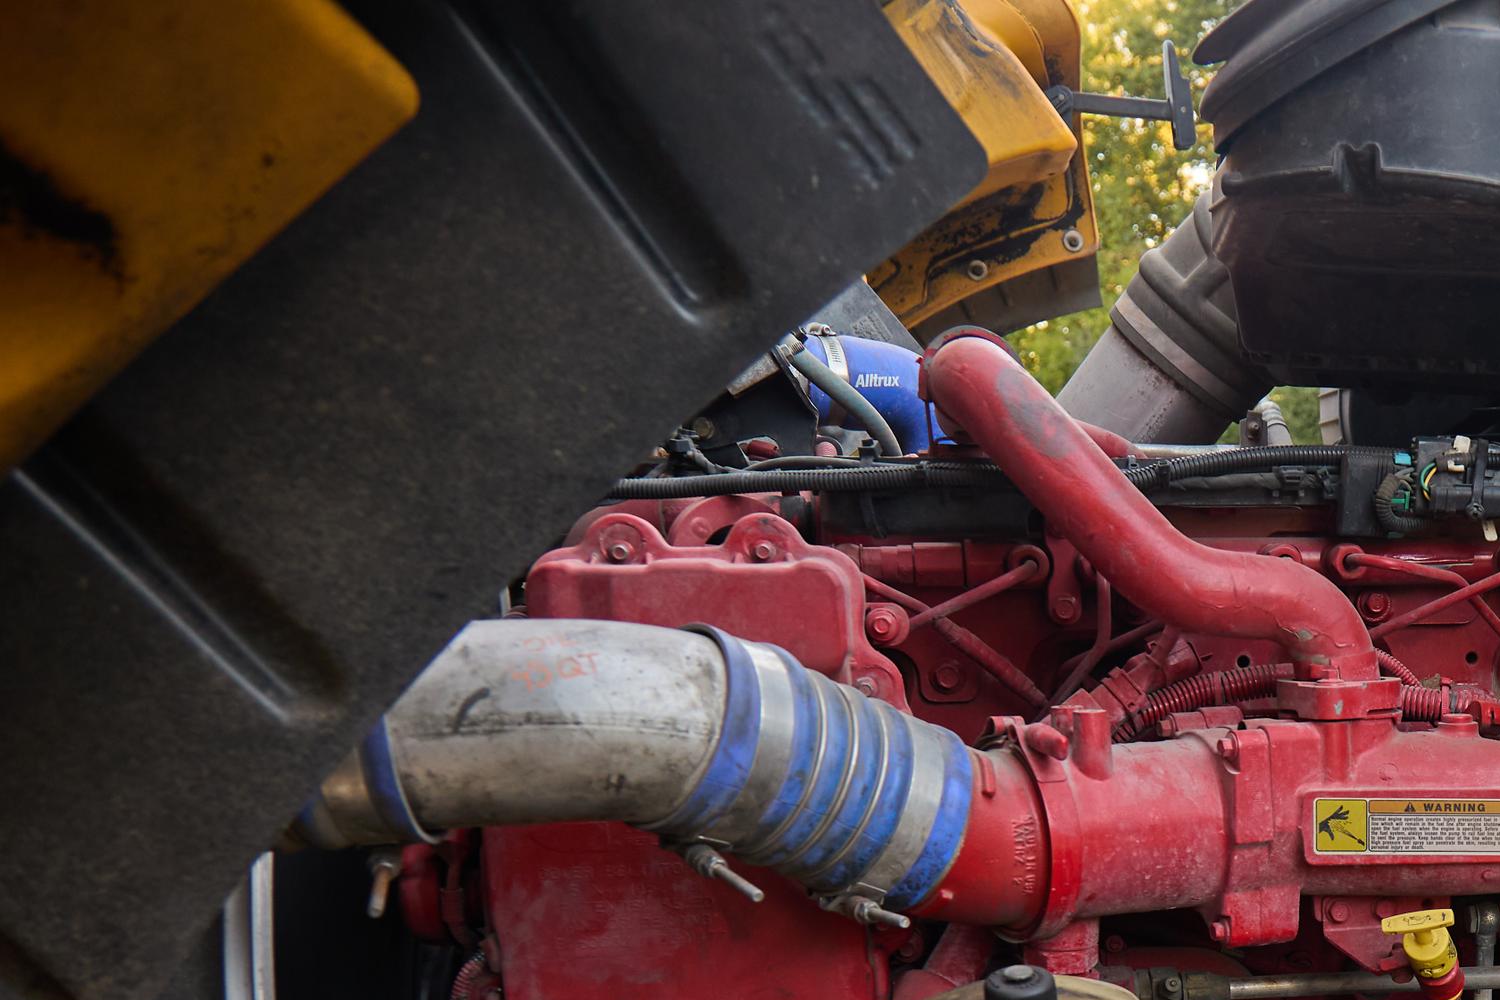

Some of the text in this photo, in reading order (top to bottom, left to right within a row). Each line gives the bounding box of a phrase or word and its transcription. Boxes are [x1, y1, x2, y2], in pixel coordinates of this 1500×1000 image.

[856, 374, 900, 388] Alltrux
[557, 652, 600, 680] QT
[1424, 803, 1486, 812] WARNING
